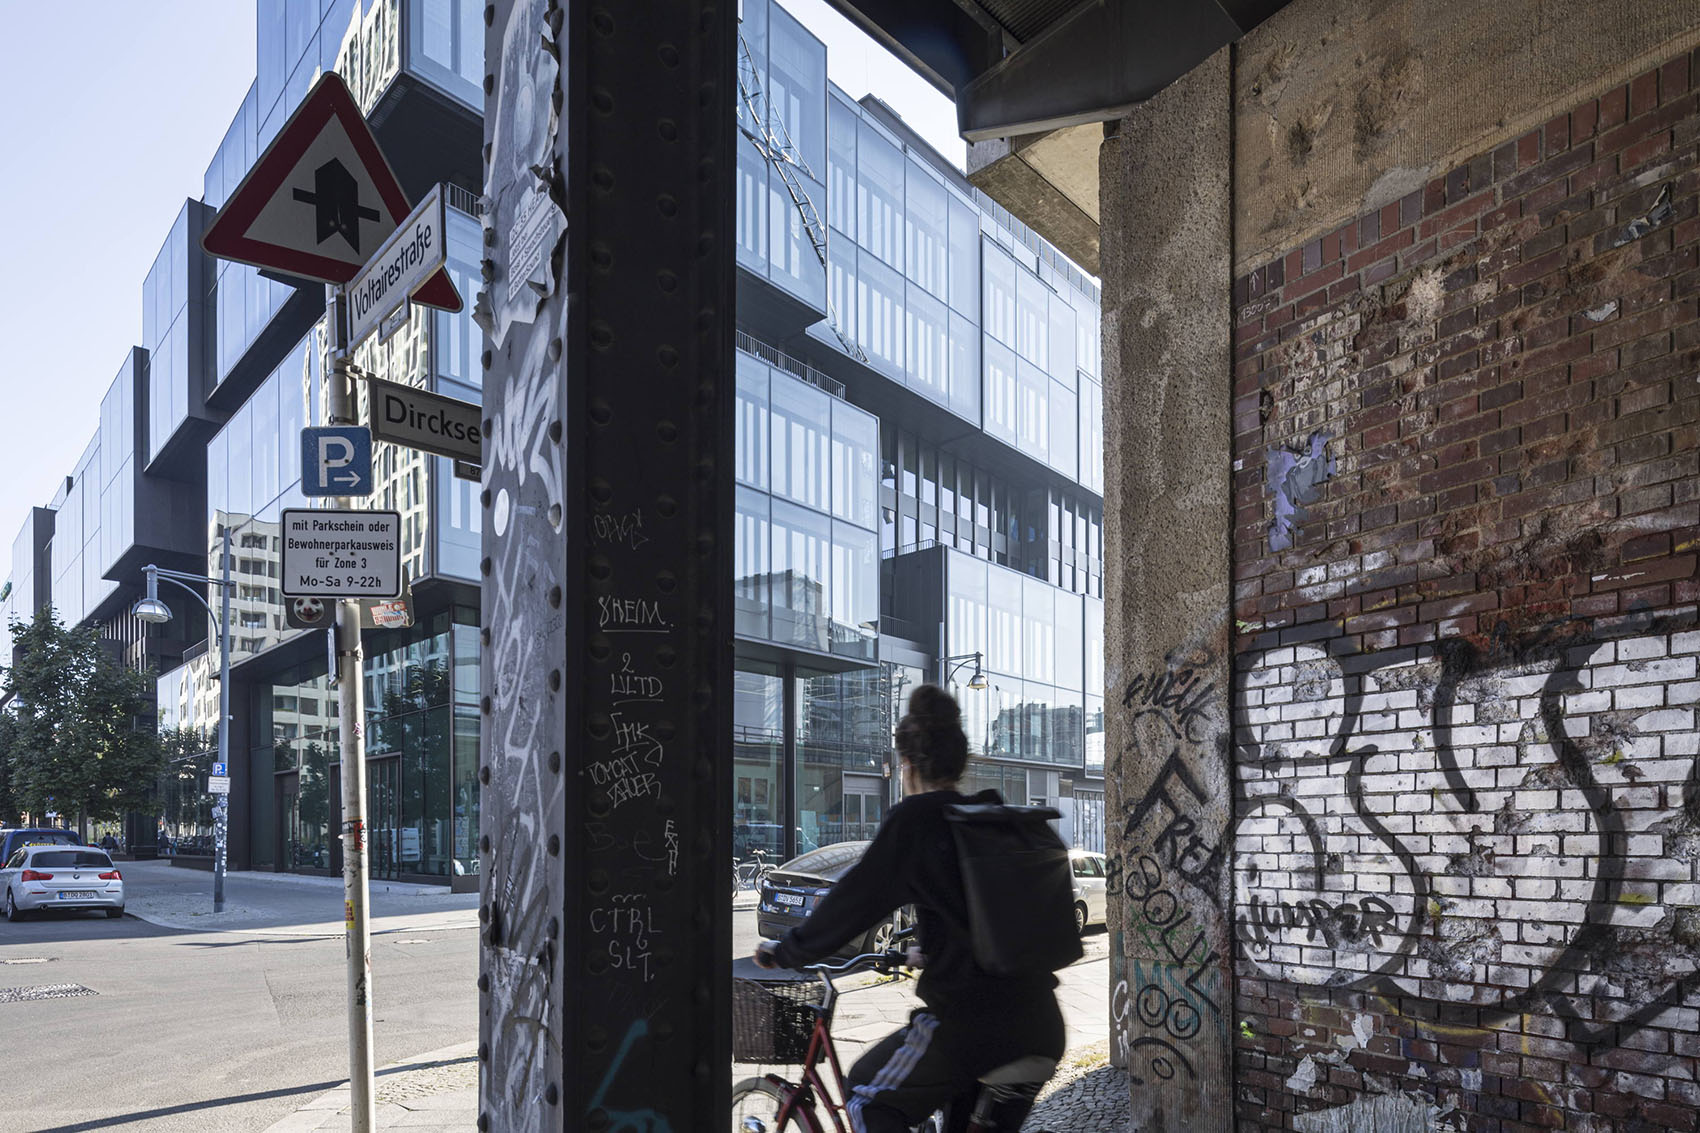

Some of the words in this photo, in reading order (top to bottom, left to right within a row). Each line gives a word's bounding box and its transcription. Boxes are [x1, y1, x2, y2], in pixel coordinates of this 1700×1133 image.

[354, 223, 432, 321] Voltairestraße
[318, 436, 355, 488] P
[292, 520, 308, 531] mit
[313, 520, 364, 532] Parkschein
[368, 521, 390, 532] oder
[288, 538, 394, 552] Bewohnerparkausweis
[315, 557, 330, 569] für
[334, 557, 357, 569] Zone
[361, 558, 367, 569] 3
[300, 576, 341, 587] Mo-Sa
[346, 576, 382, 588] 9-22h
[590, 907, 662, 946] CTRL
